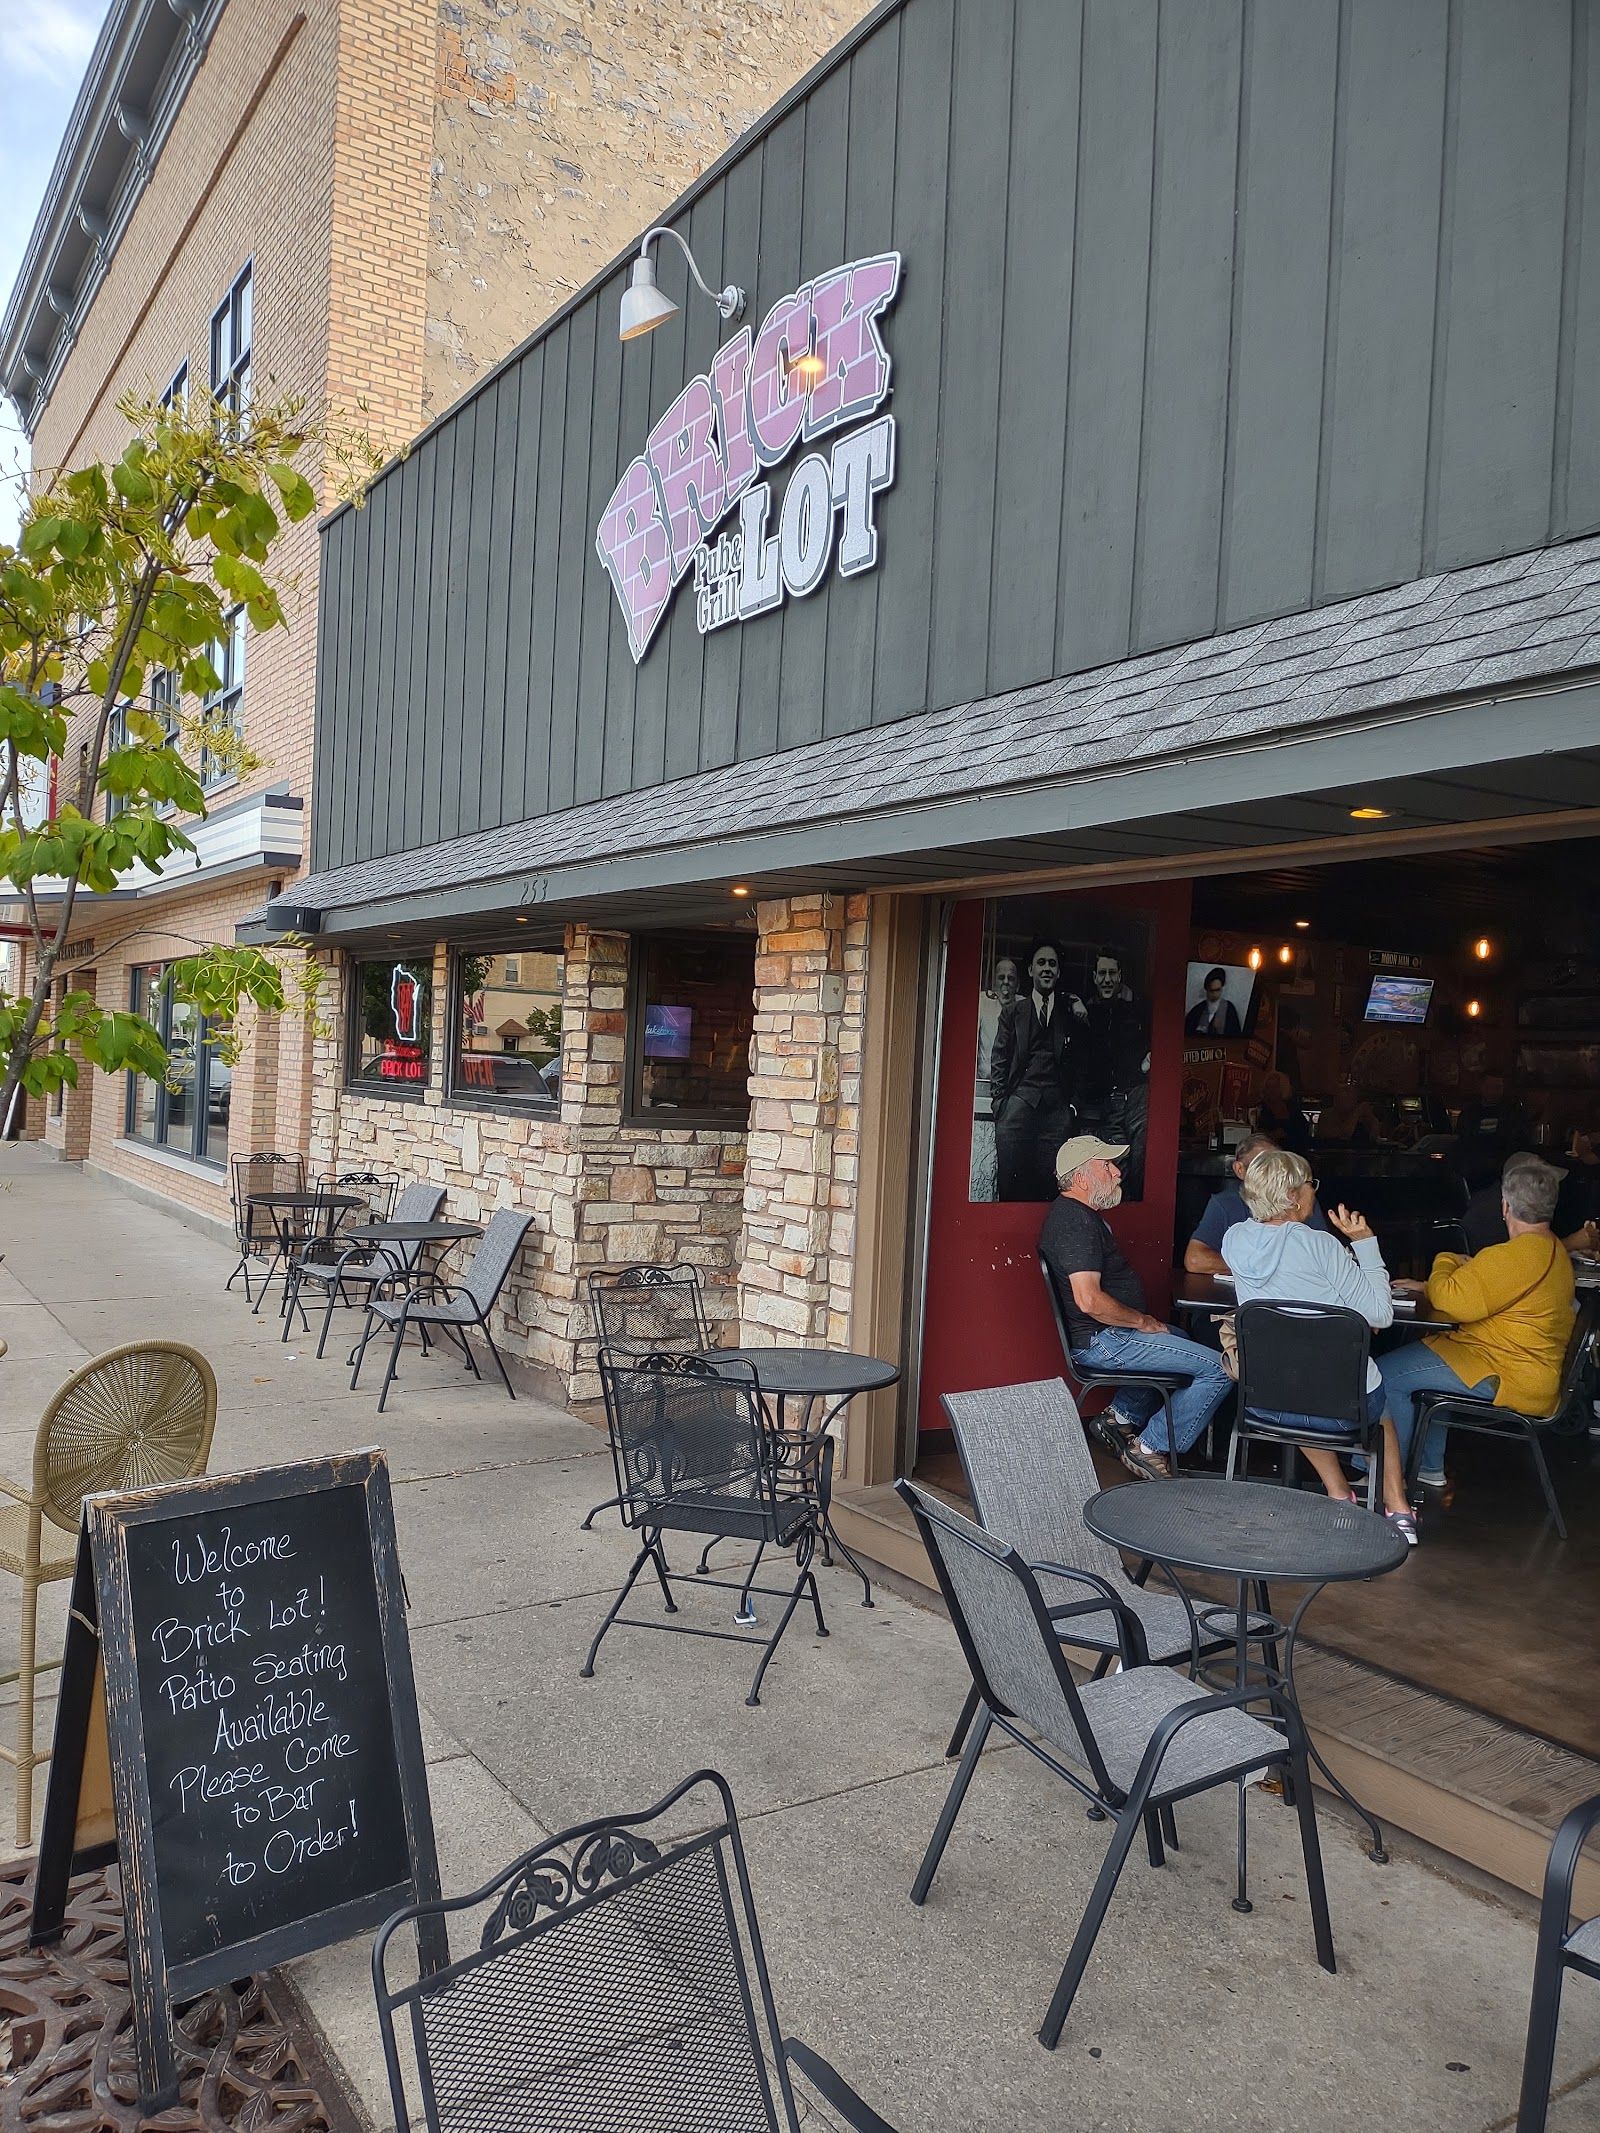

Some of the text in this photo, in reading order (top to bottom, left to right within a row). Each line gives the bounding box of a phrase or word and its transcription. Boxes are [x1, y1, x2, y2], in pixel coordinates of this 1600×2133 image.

[598, 253, 899, 663] BRICK
[739, 416, 893, 618] LOT
[697, 576, 737, 630] Grill
[520, 879, 548, 906] 253
[463, 1058, 496, 1087] OPEN
[172, 1527, 298, 1585] Welcome
[216, 1581, 245, 1610] to
[152, 1609, 252, 1664] Brick
[159, 1643, 348, 1715] Patio Seating
[212, 1689, 330, 1754] Available
[169, 1734, 359, 1814] Please Come
[231, 1778, 325, 1829] to Bar
[221, 1798, 359, 1886] to Order!
